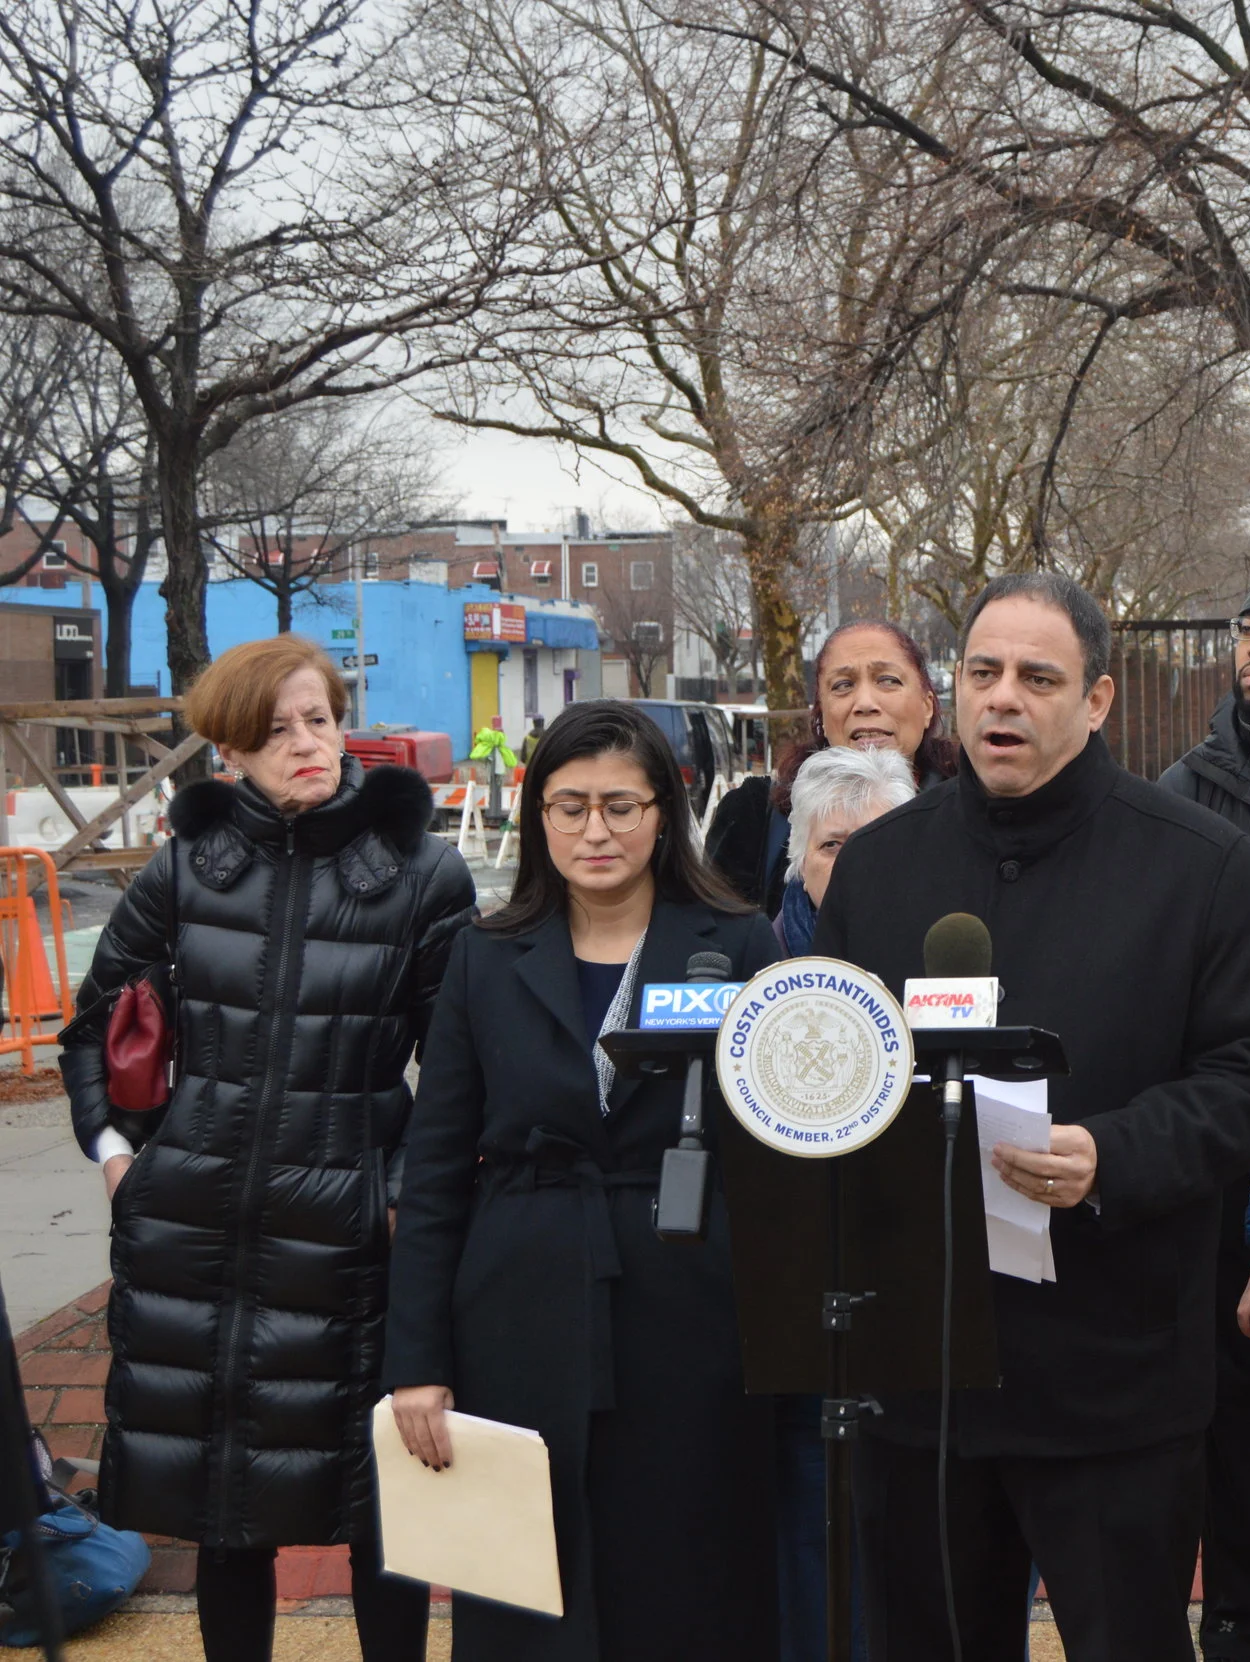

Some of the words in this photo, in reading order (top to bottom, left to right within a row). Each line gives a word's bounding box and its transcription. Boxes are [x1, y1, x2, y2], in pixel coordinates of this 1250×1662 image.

[908, 993, 975, 1007] AKTINA
[730, 1000, 765, 1058] COSTA
[763, 973, 900, 1053] CONSTANTINIDES
[950, 1006, 974, 1019] TV
[644, 1018, 664, 1026] NEW
[665, 1017, 696, 1026] YORK'S
[697, 1017, 720, 1025] VERY
[736, 1078, 771, 1128] COUNCIL
[774, 1123, 834, 1143] MEMBER,
[836, 1120, 859, 1139] 22ND
[860, 1071, 896, 1125] DISTRICT
